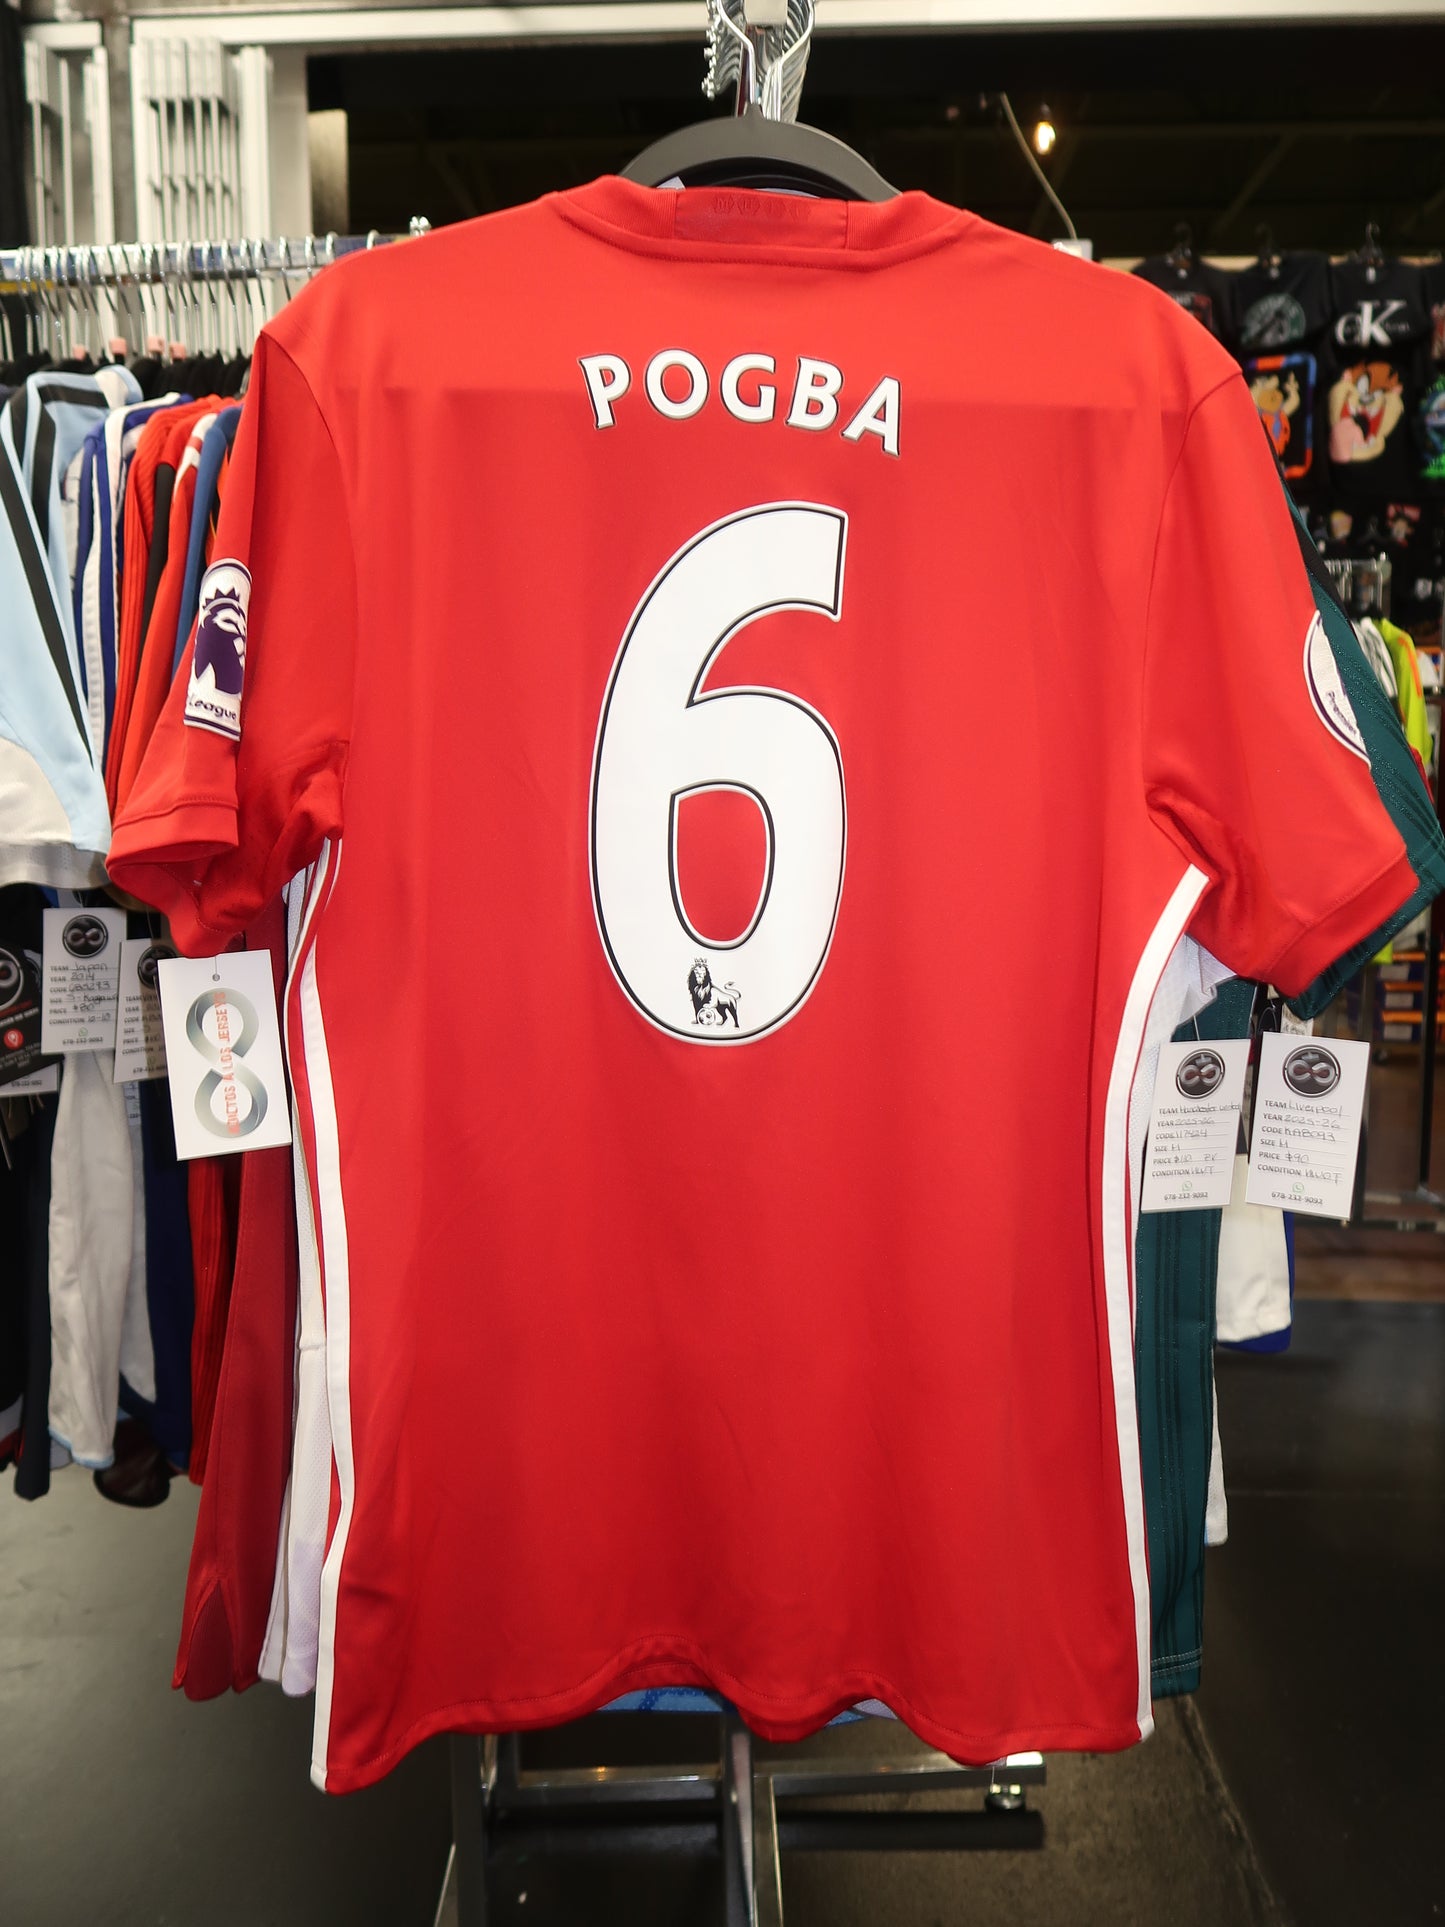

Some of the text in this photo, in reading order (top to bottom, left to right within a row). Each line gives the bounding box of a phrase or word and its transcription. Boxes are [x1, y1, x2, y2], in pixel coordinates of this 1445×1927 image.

[577, 348, 902, 458] POGBA
[589, 500, 849, 1046] 6
[220, 1047, 233, 1070] LOS
[1159, 1107, 1178, 1115] TEAM
[1264, 1099, 1343, 1118] TEAM Liverpool
[1263, 1112, 1283, 1121] YEAR
[1261, 1125, 1283, 1135] CODE
[1260, 1138, 1276, 1147] SIZE
[1153, 1157, 1172, 1165] PRICE
[1258, 1151, 1310, 1163] PRICE $90
[1151, 1168, 1190, 1177] CONDITION
[1257, 1163, 1301, 1176] CONDITION
